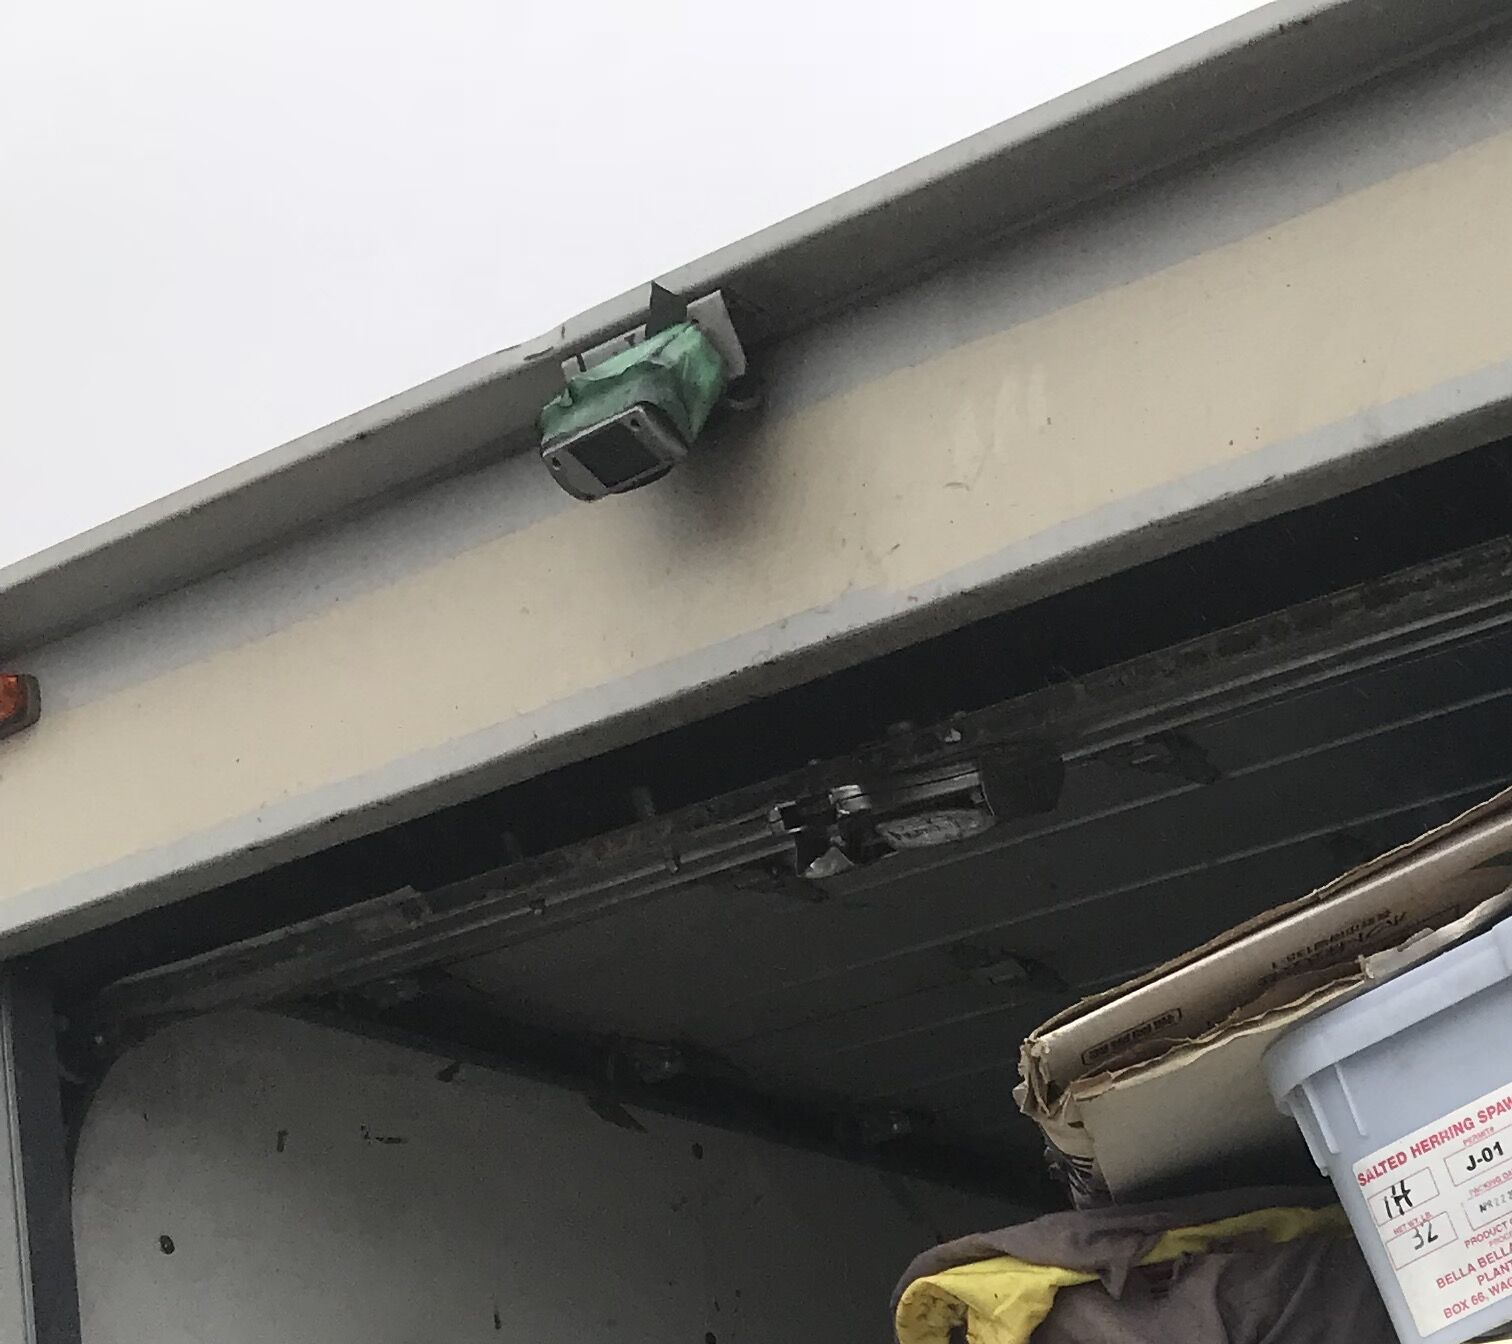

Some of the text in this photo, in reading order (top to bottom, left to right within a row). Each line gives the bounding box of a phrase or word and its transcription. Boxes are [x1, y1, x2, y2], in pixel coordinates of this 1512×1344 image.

[1357, 1151, 1408, 1187] SALTED
[1409, 1117, 1475, 1158] HERRING
[1466, 1141, 1504, 1171] J-01
[1464, 1220, 1508, 1248] PRODUCT
[1436, 1263, 1477, 1289] BELLA
[1443, 1297, 1470, 1319] BOX
